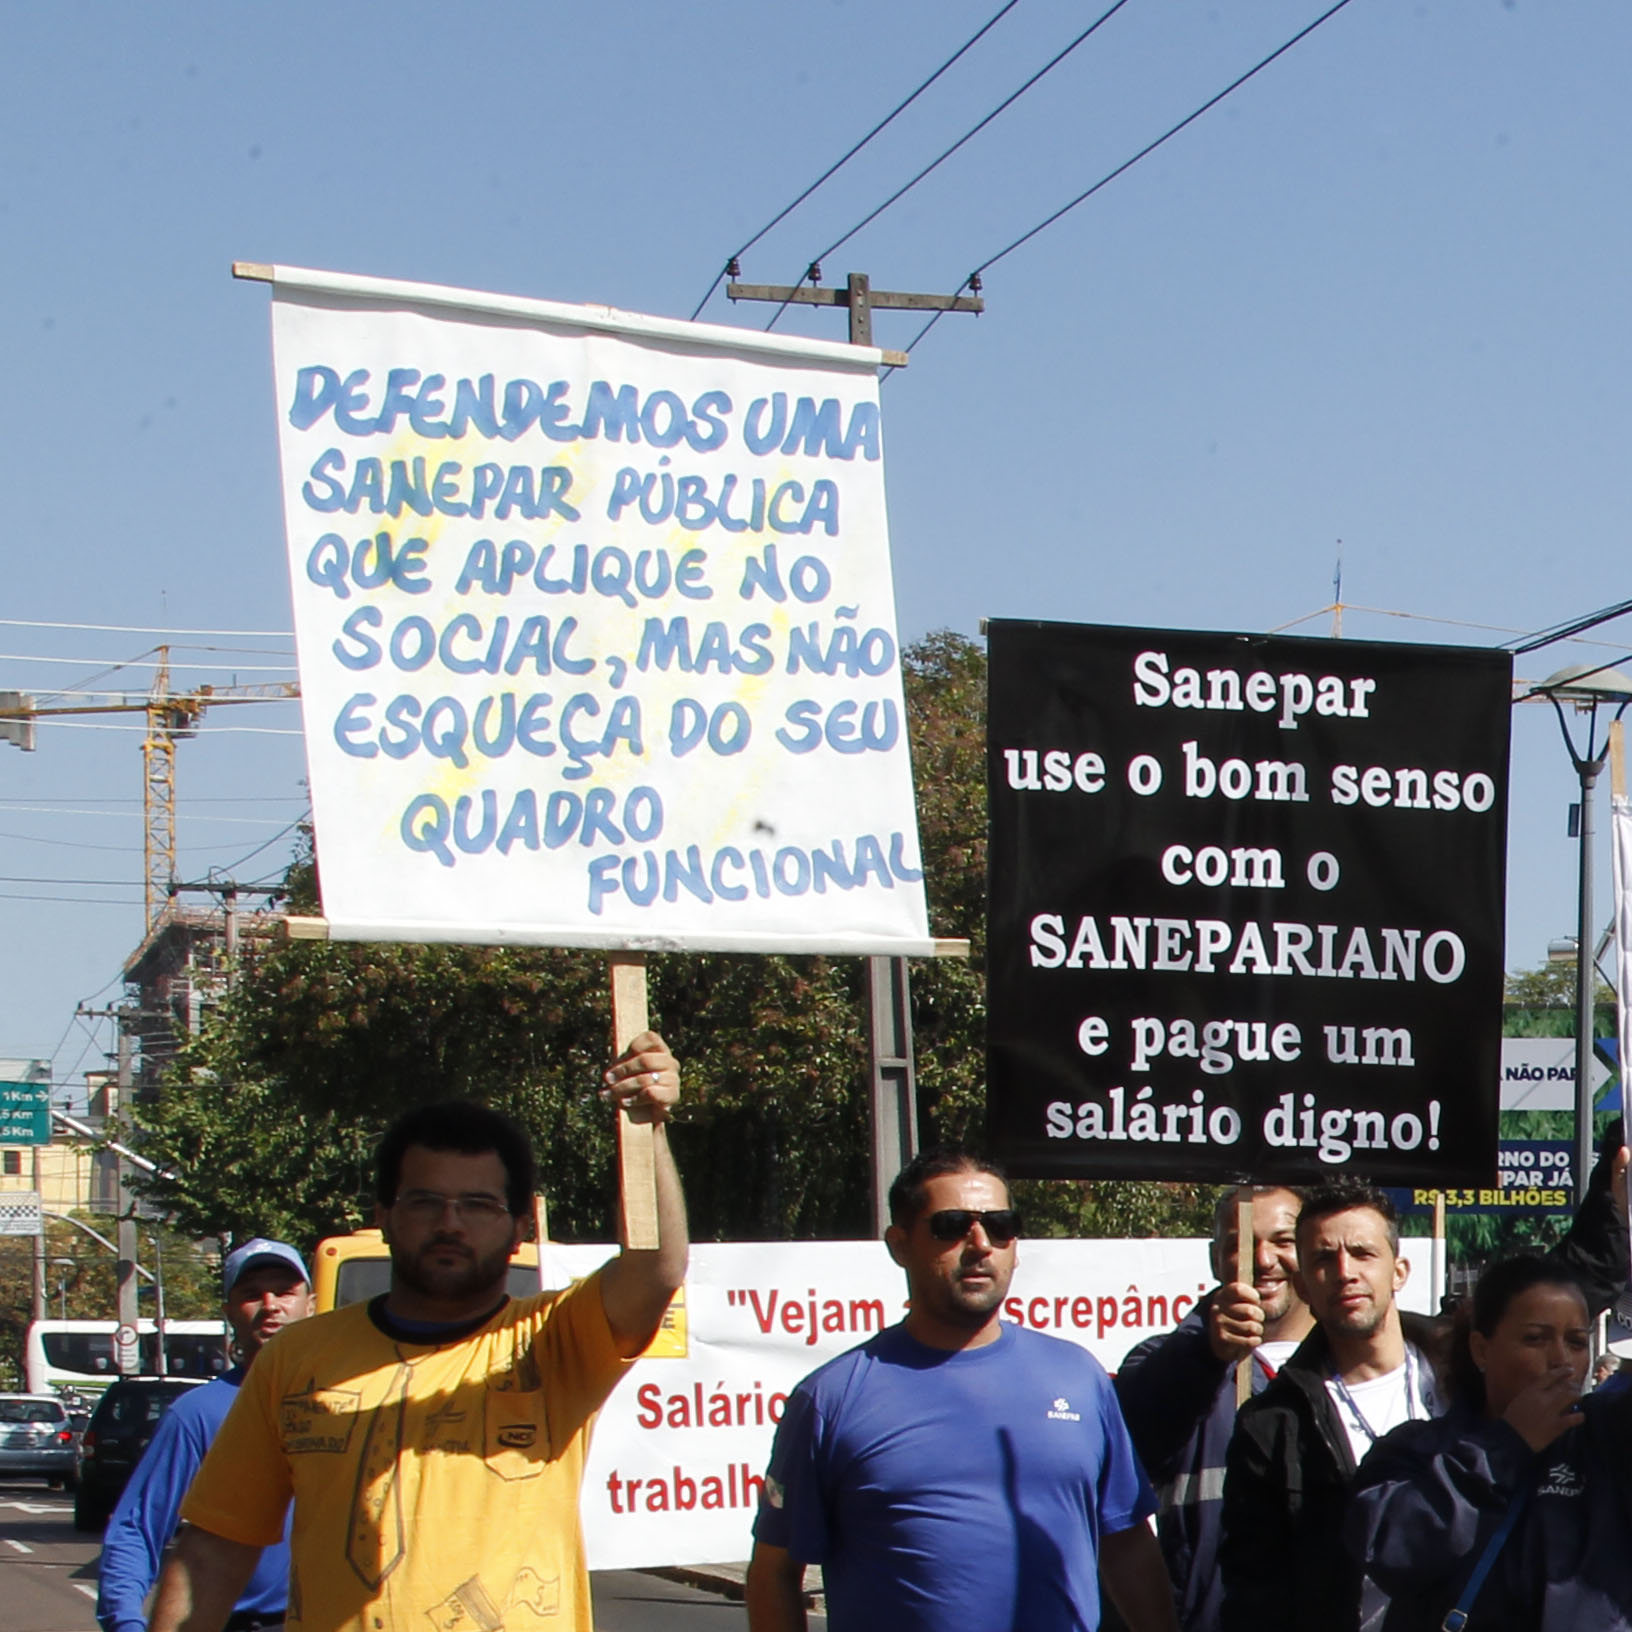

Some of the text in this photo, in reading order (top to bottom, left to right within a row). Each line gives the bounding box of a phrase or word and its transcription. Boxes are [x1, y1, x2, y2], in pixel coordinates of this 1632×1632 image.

[289, 365, 881, 463] DEFENDEMOS UMA
[302, 448, 841, 536] SANEPAR PÚBLICA
[306, 532, 831, 608] QUE APLIQUE NO
[635, 614, 775, 677] MAS
[785, 603, 896, 677] NÃO
[1132, 651, 1377, 729] Sanepar
[332, 692, 899, 781] ESQUEÇA DO SEU
[1004, 740, 1496, 813] use o bom senso
[399, 786, 665, 867] QUADRO
[587, 830, 925, 916] FUNCIONAL
[1160, 843, 1340, 891] com o
[1028, 912, 1467, 985] SANEPARIANO
[1077, 1015, 1416, 1076] e pague um
[1505, 1062, 1545, 1081] NÃO
[1045, 1086, 1443, 1165] salário digno!
[1540, 1151, 1570, 1167] DO
[1479, 1186, 1567, 1206] BILHÕES
[1548, 1166, 1575, 1187] JÁ
